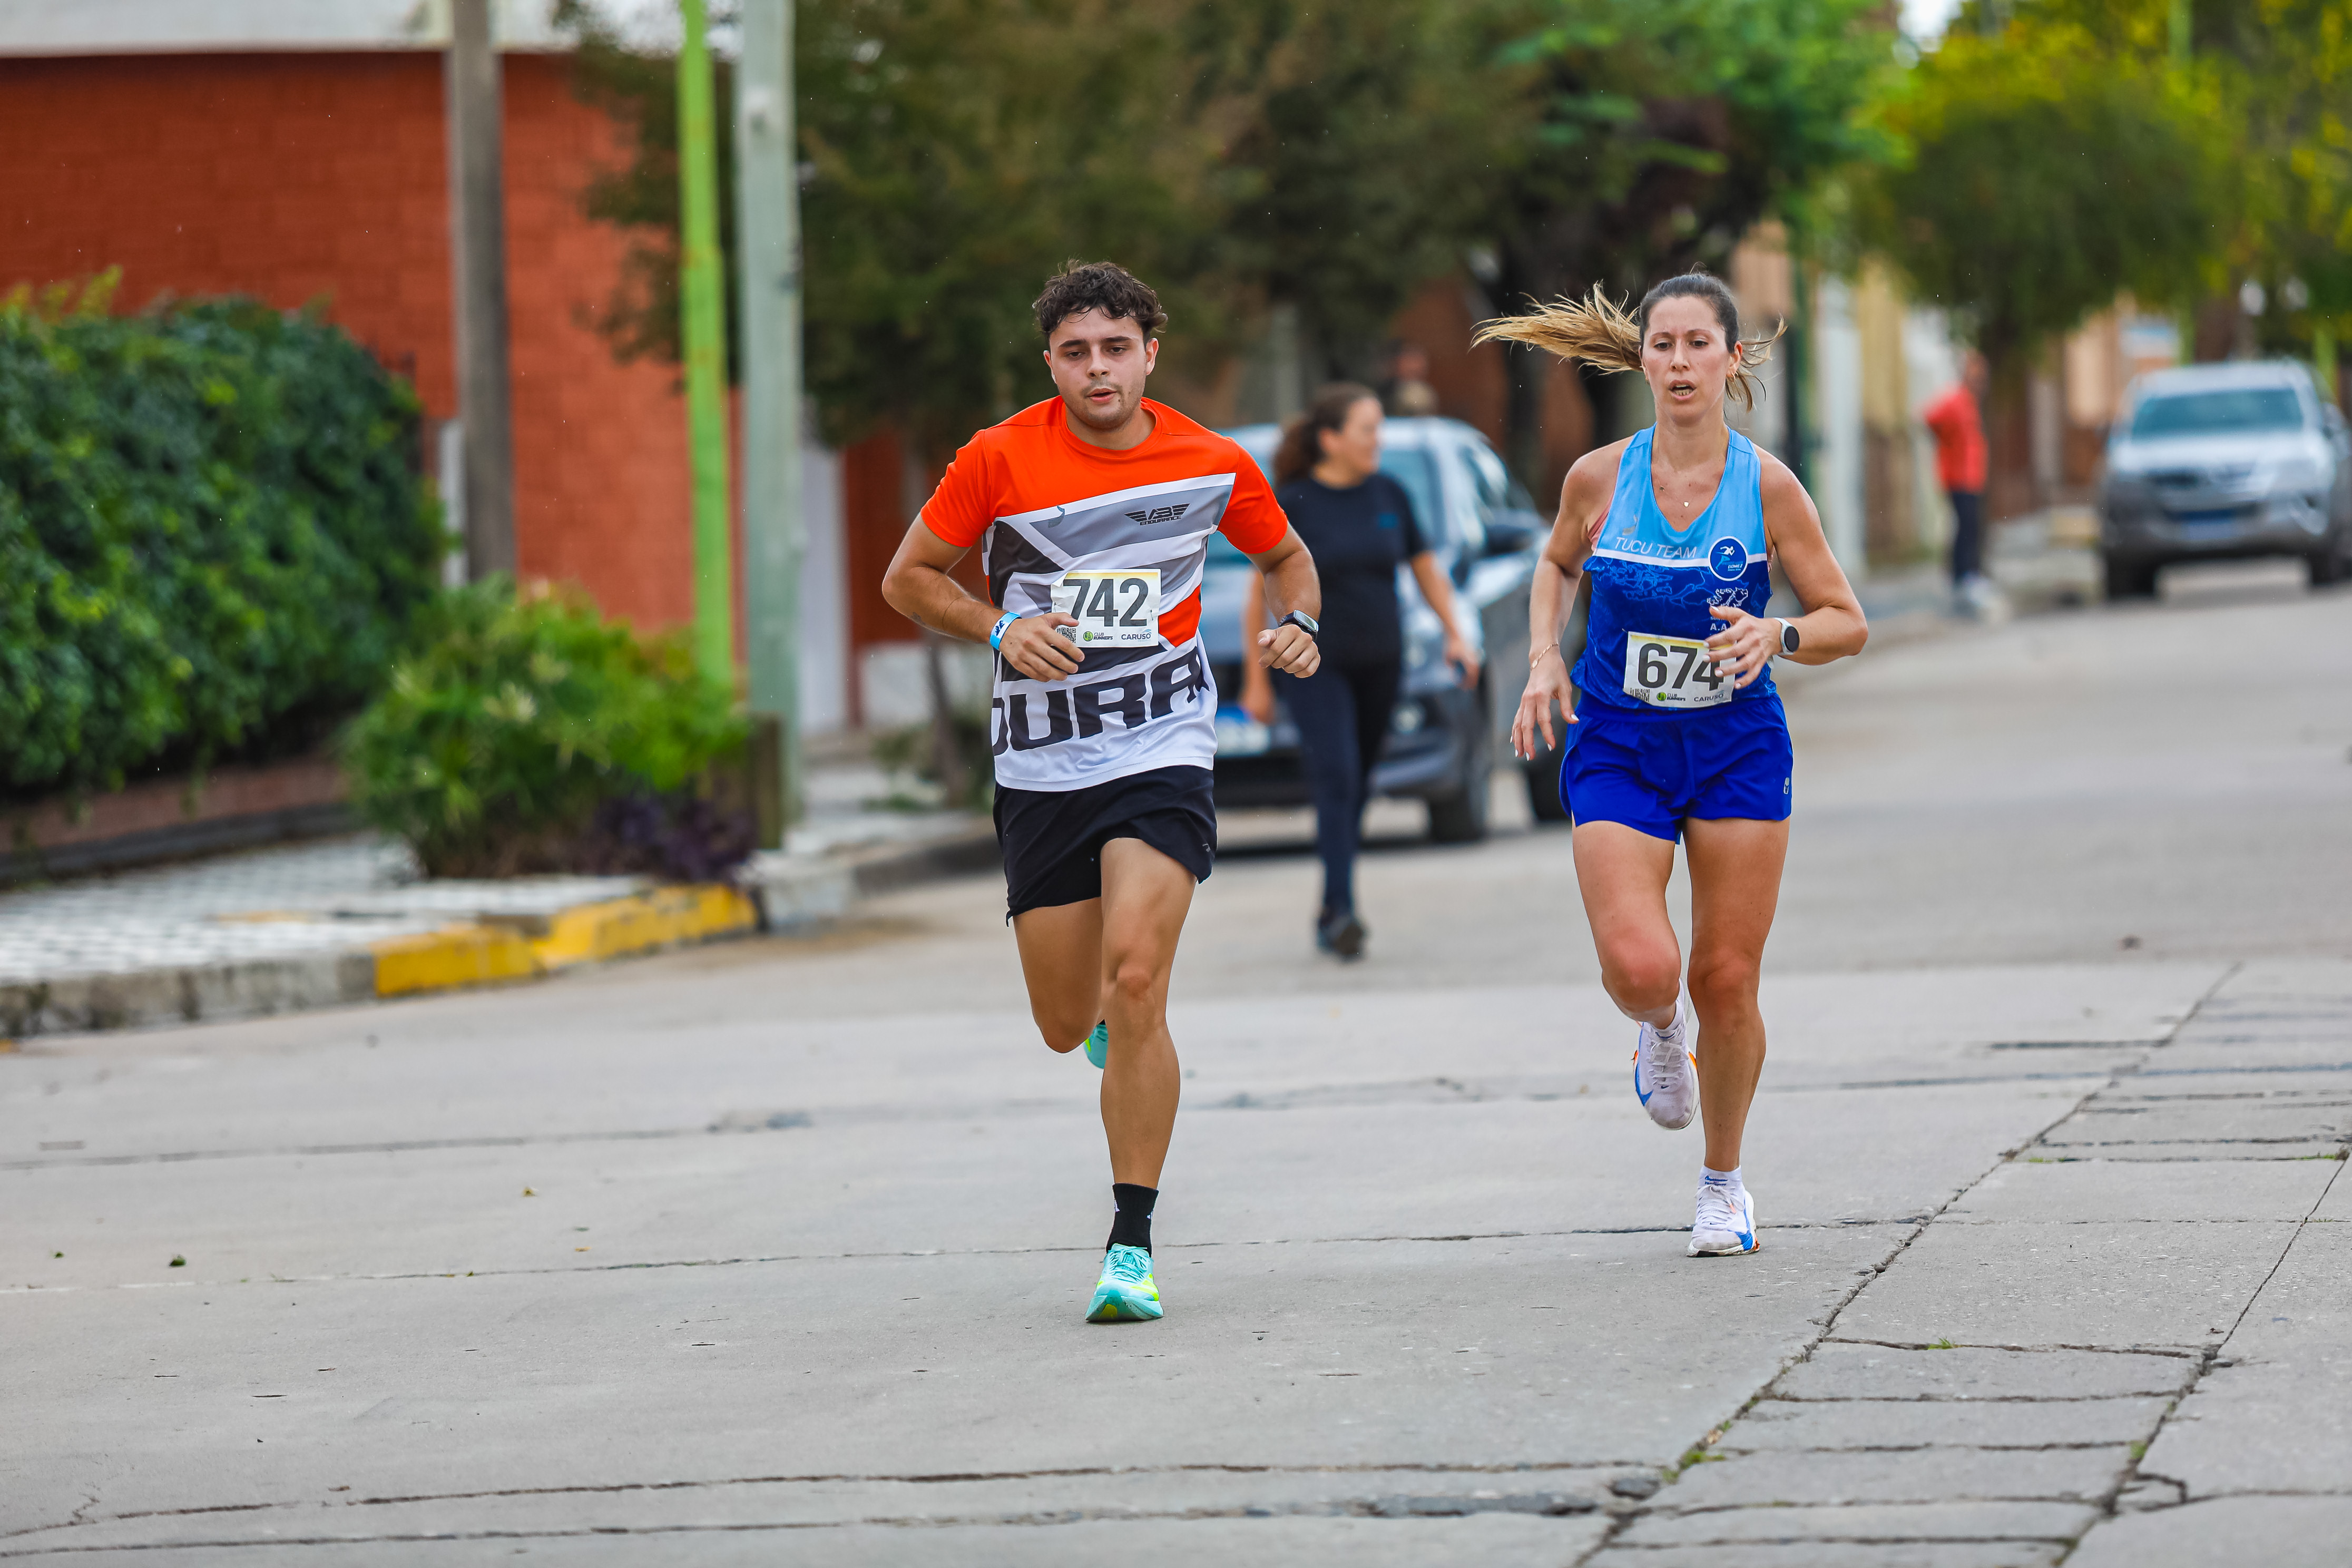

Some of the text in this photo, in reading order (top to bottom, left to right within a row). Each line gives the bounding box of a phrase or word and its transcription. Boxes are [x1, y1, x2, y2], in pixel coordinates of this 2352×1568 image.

[1140, 516, 1182, 526] ENDURANCE
[1615, 537, 1698, 558] TUCU TEAM
[1063, 577, 1149, 627] 742
[1638, 643, 1724, 691] 674
[1694, 693, 1724, 702] CARUSO
